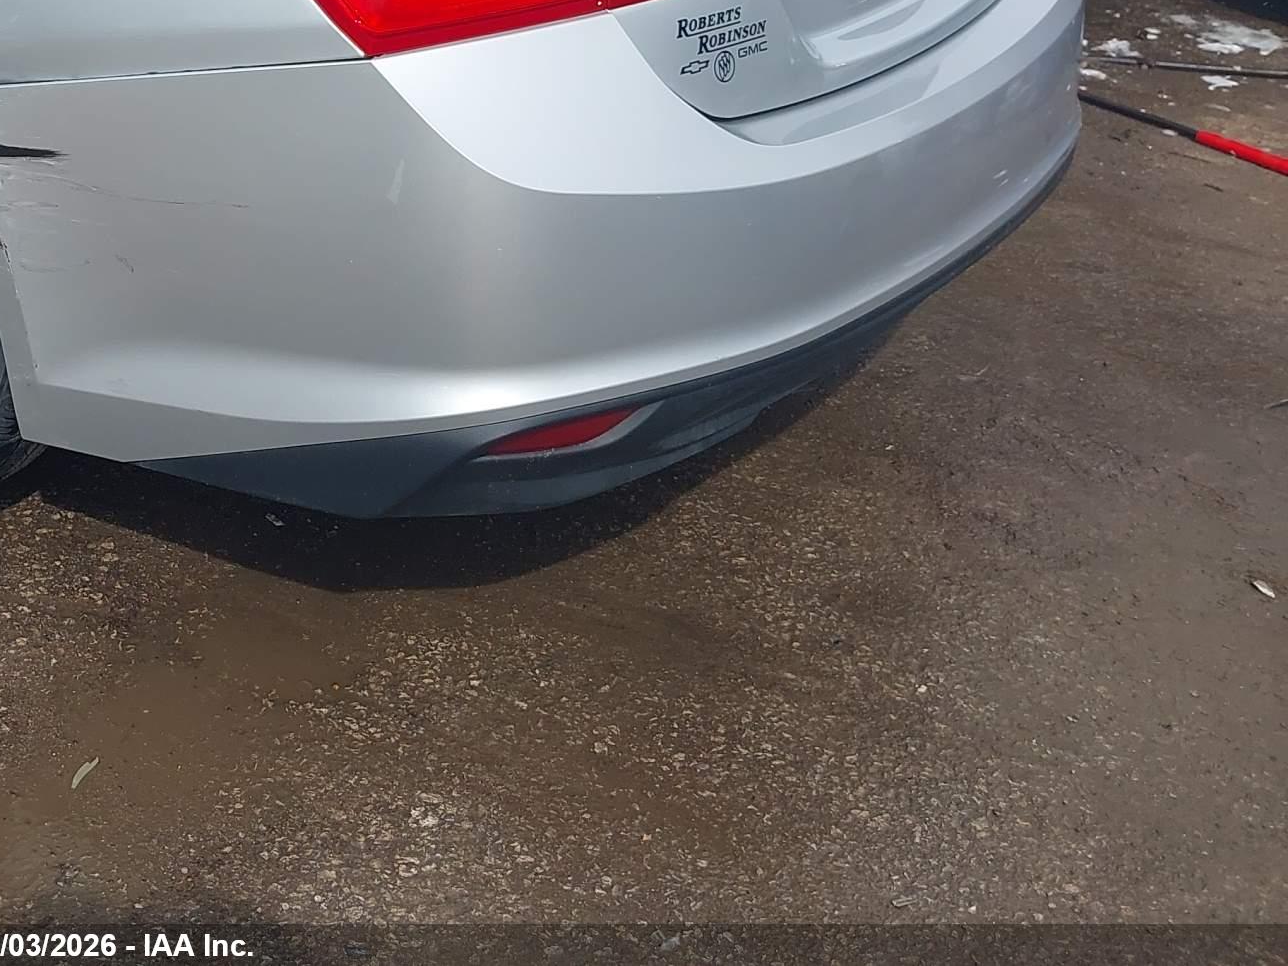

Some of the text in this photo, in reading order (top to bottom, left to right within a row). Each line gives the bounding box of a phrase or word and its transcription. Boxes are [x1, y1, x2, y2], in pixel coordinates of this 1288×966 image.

[676, 6, 742, 39] ROBERTS
[697, 19, 767, 55] ROBINSON
[737, 40, 768, 58] GMC
